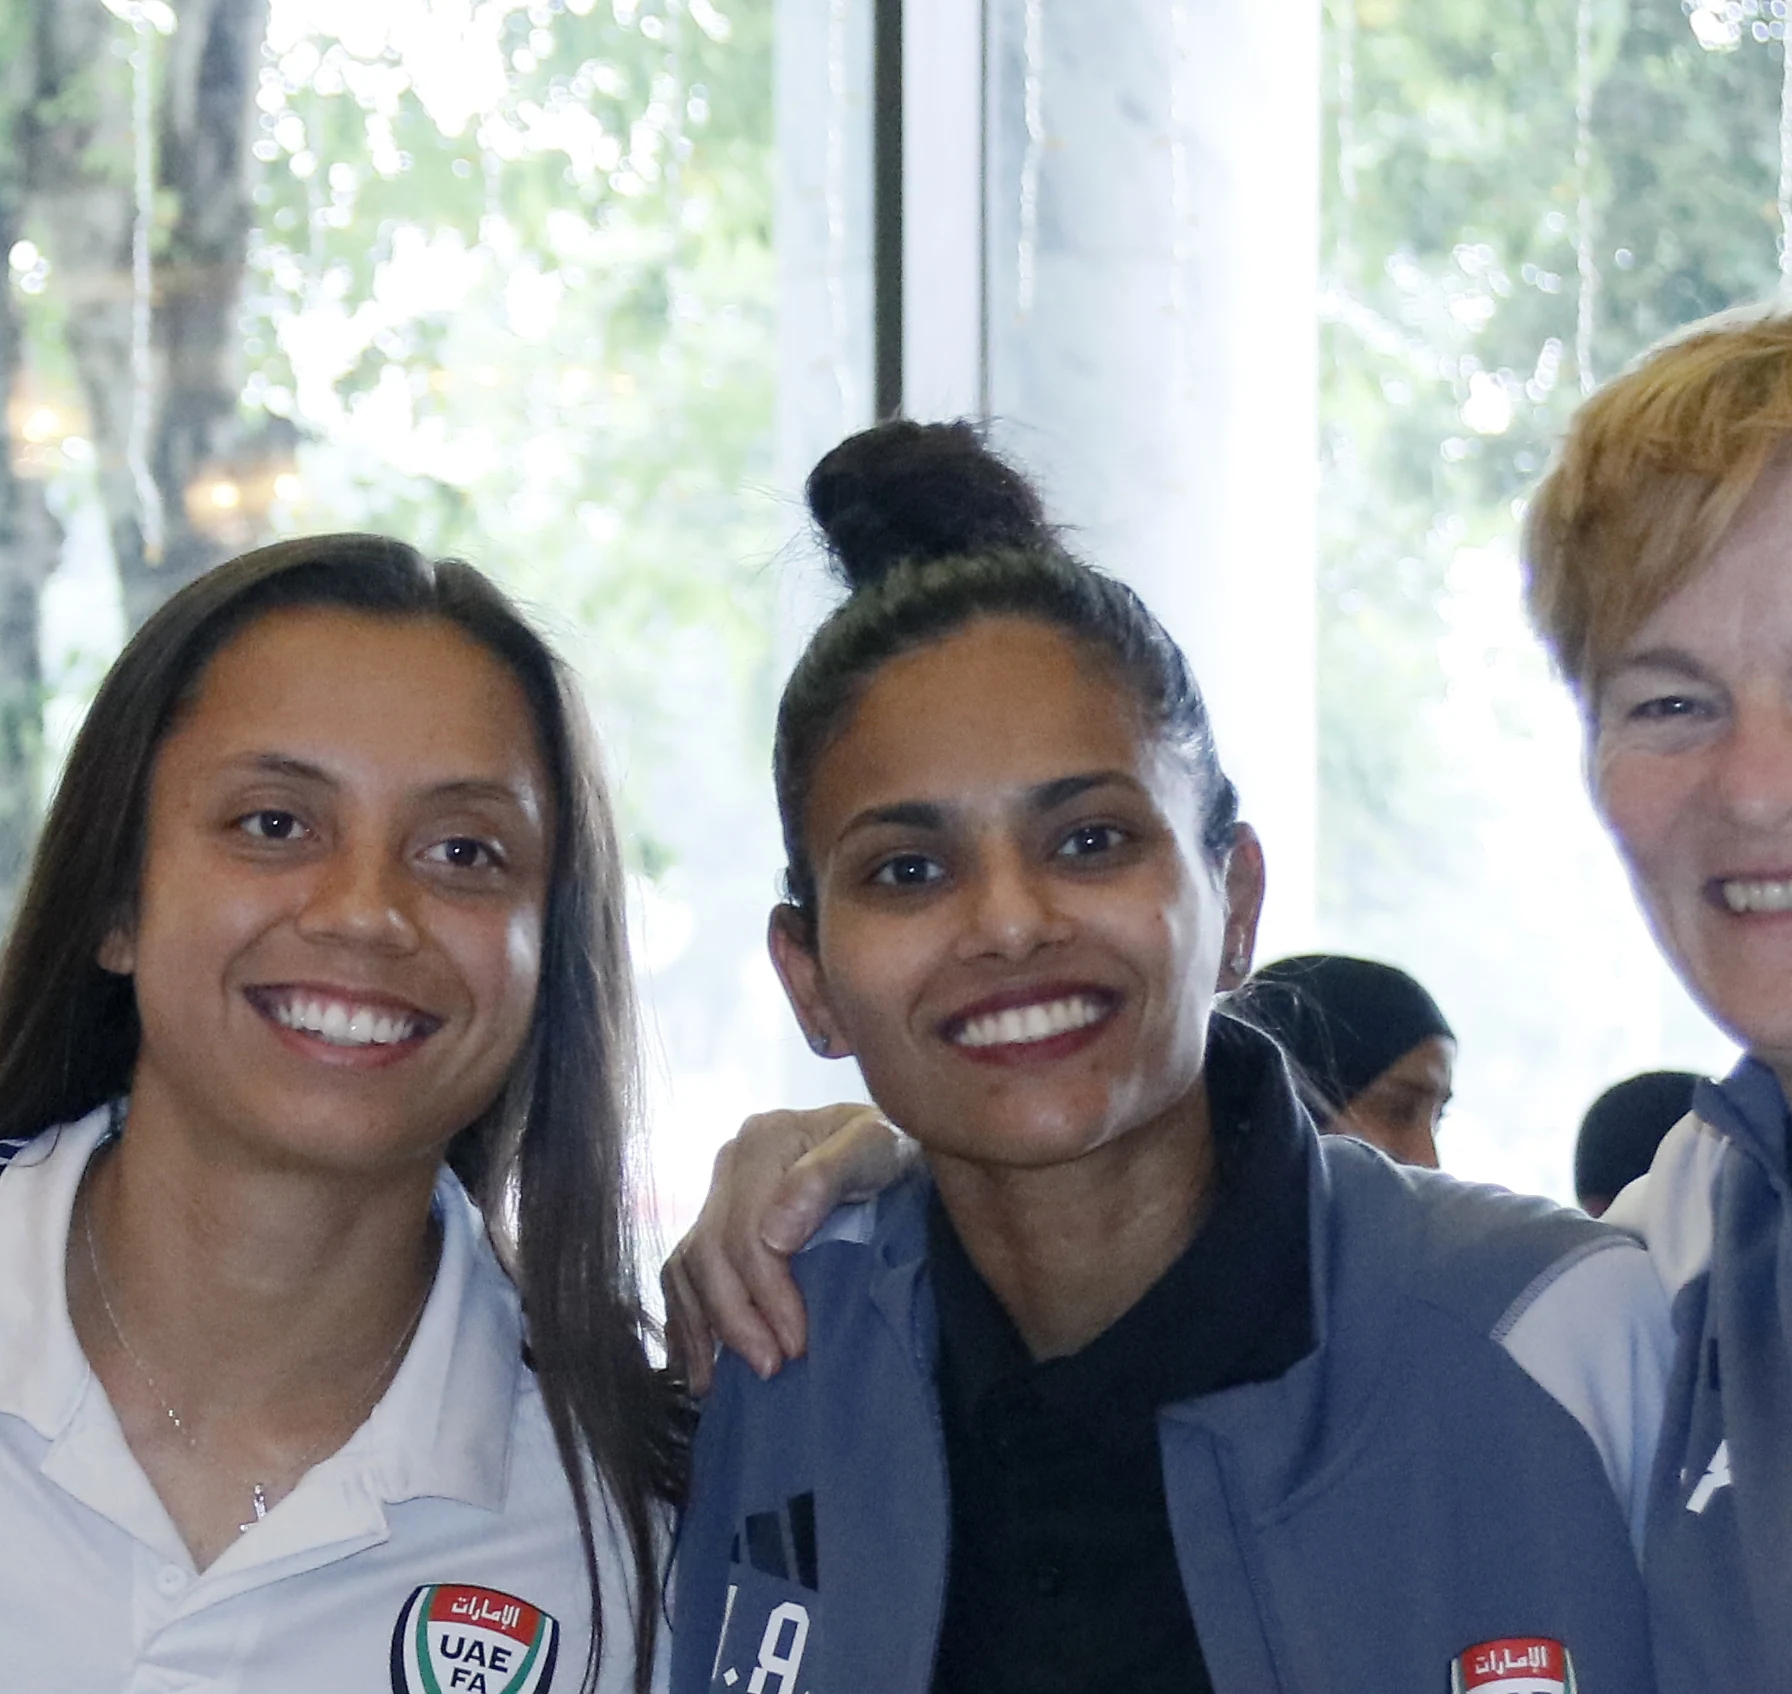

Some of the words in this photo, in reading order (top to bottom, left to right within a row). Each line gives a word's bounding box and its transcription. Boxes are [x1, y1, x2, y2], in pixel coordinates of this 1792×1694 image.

[450, 1595, 522, 1630] الإمارات
[439, 1634, 512, 1674] UAE
[1474, 1644, 1549, 1675] الإمارات
